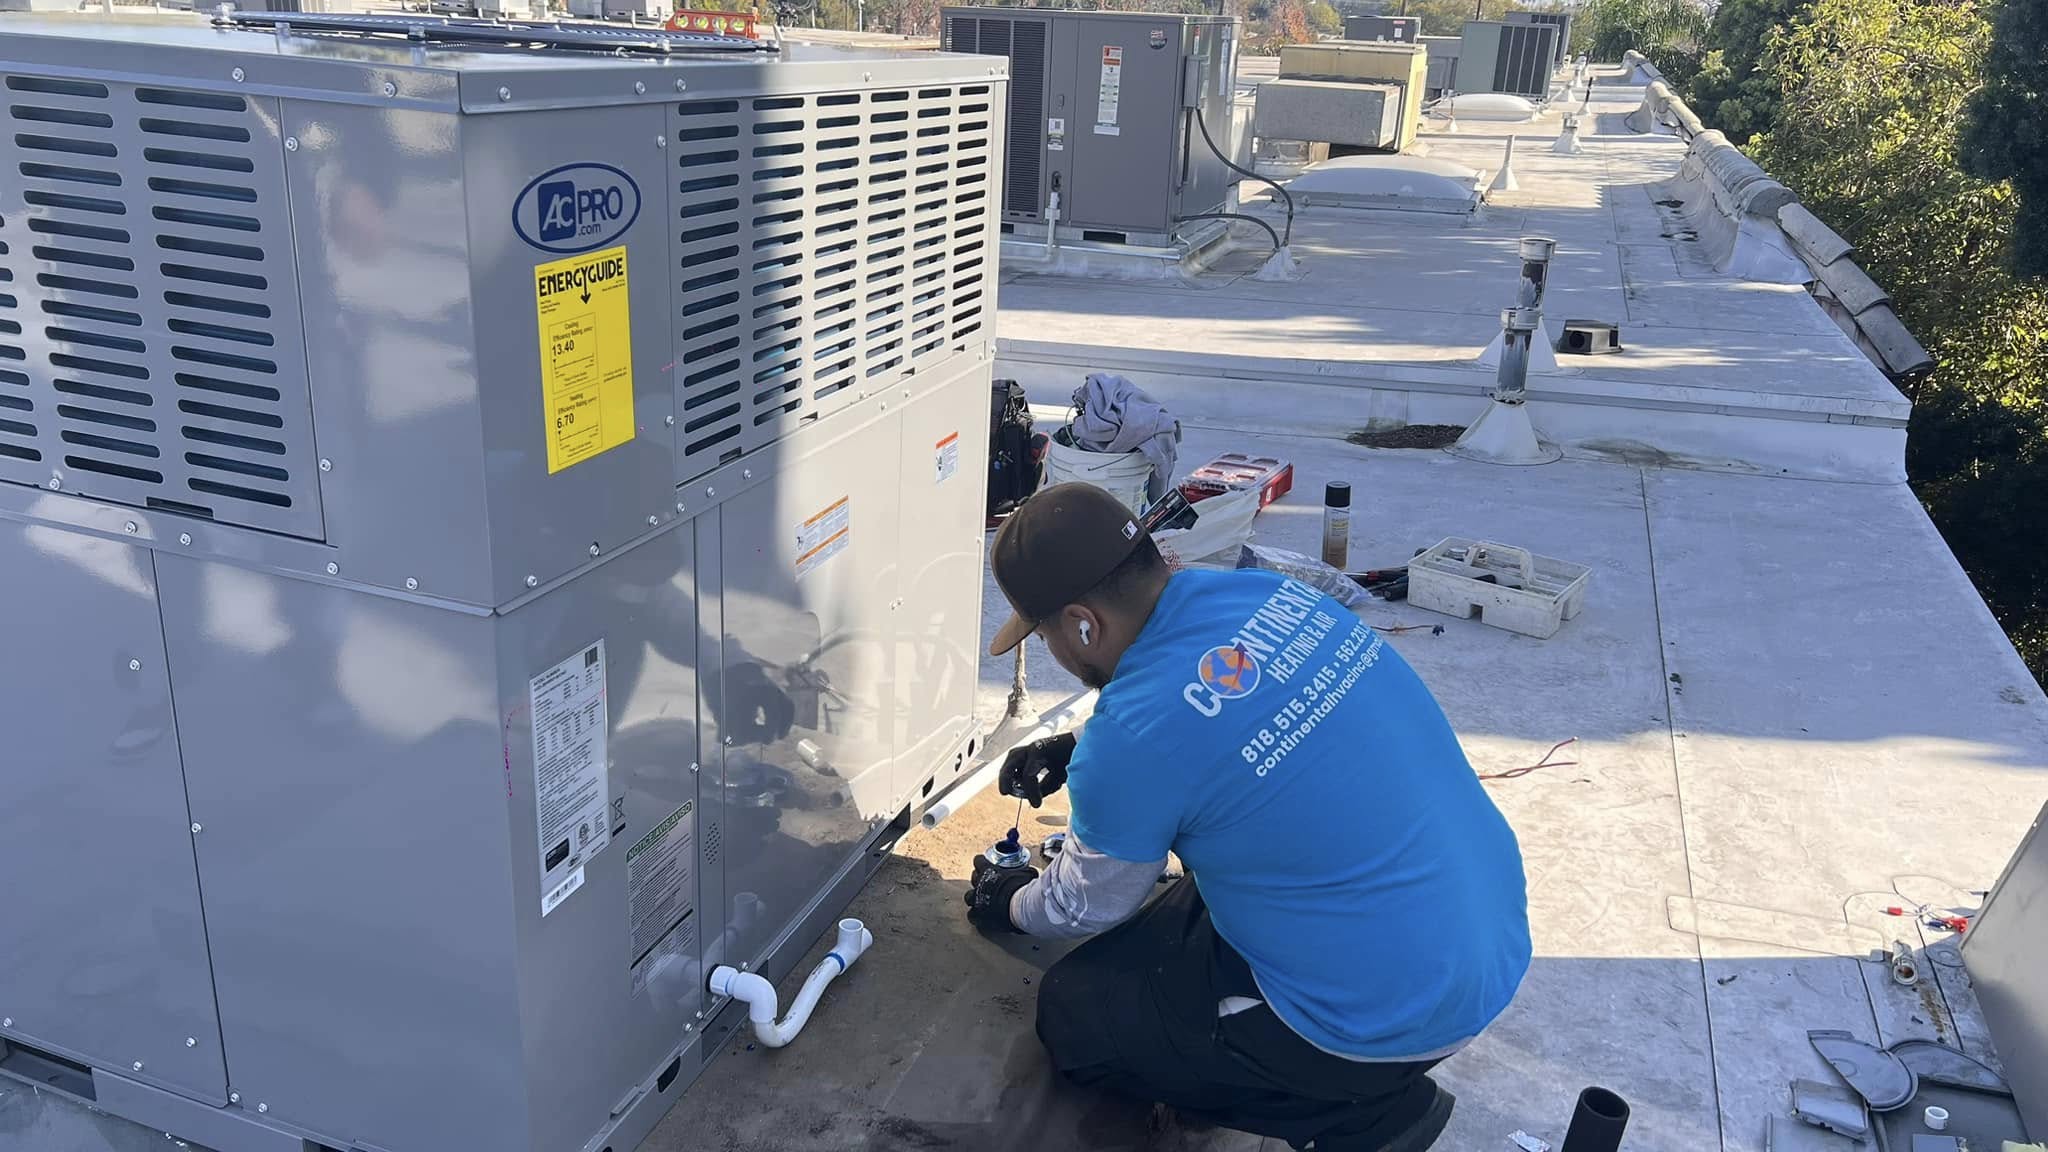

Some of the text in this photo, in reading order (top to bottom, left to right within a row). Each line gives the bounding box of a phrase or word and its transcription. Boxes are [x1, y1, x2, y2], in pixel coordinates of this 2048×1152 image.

[578, 223, 602, 237] .com
[538, 257, 624, 298] ENERGYGUIDE
[552, 339, 575, 357] 13.40
[557, 412, 575, 429] 6.70
[1266, 610, 1338, 685] HEATING & AIR
[1241, 666, 1337, 763] 818.515.3415
